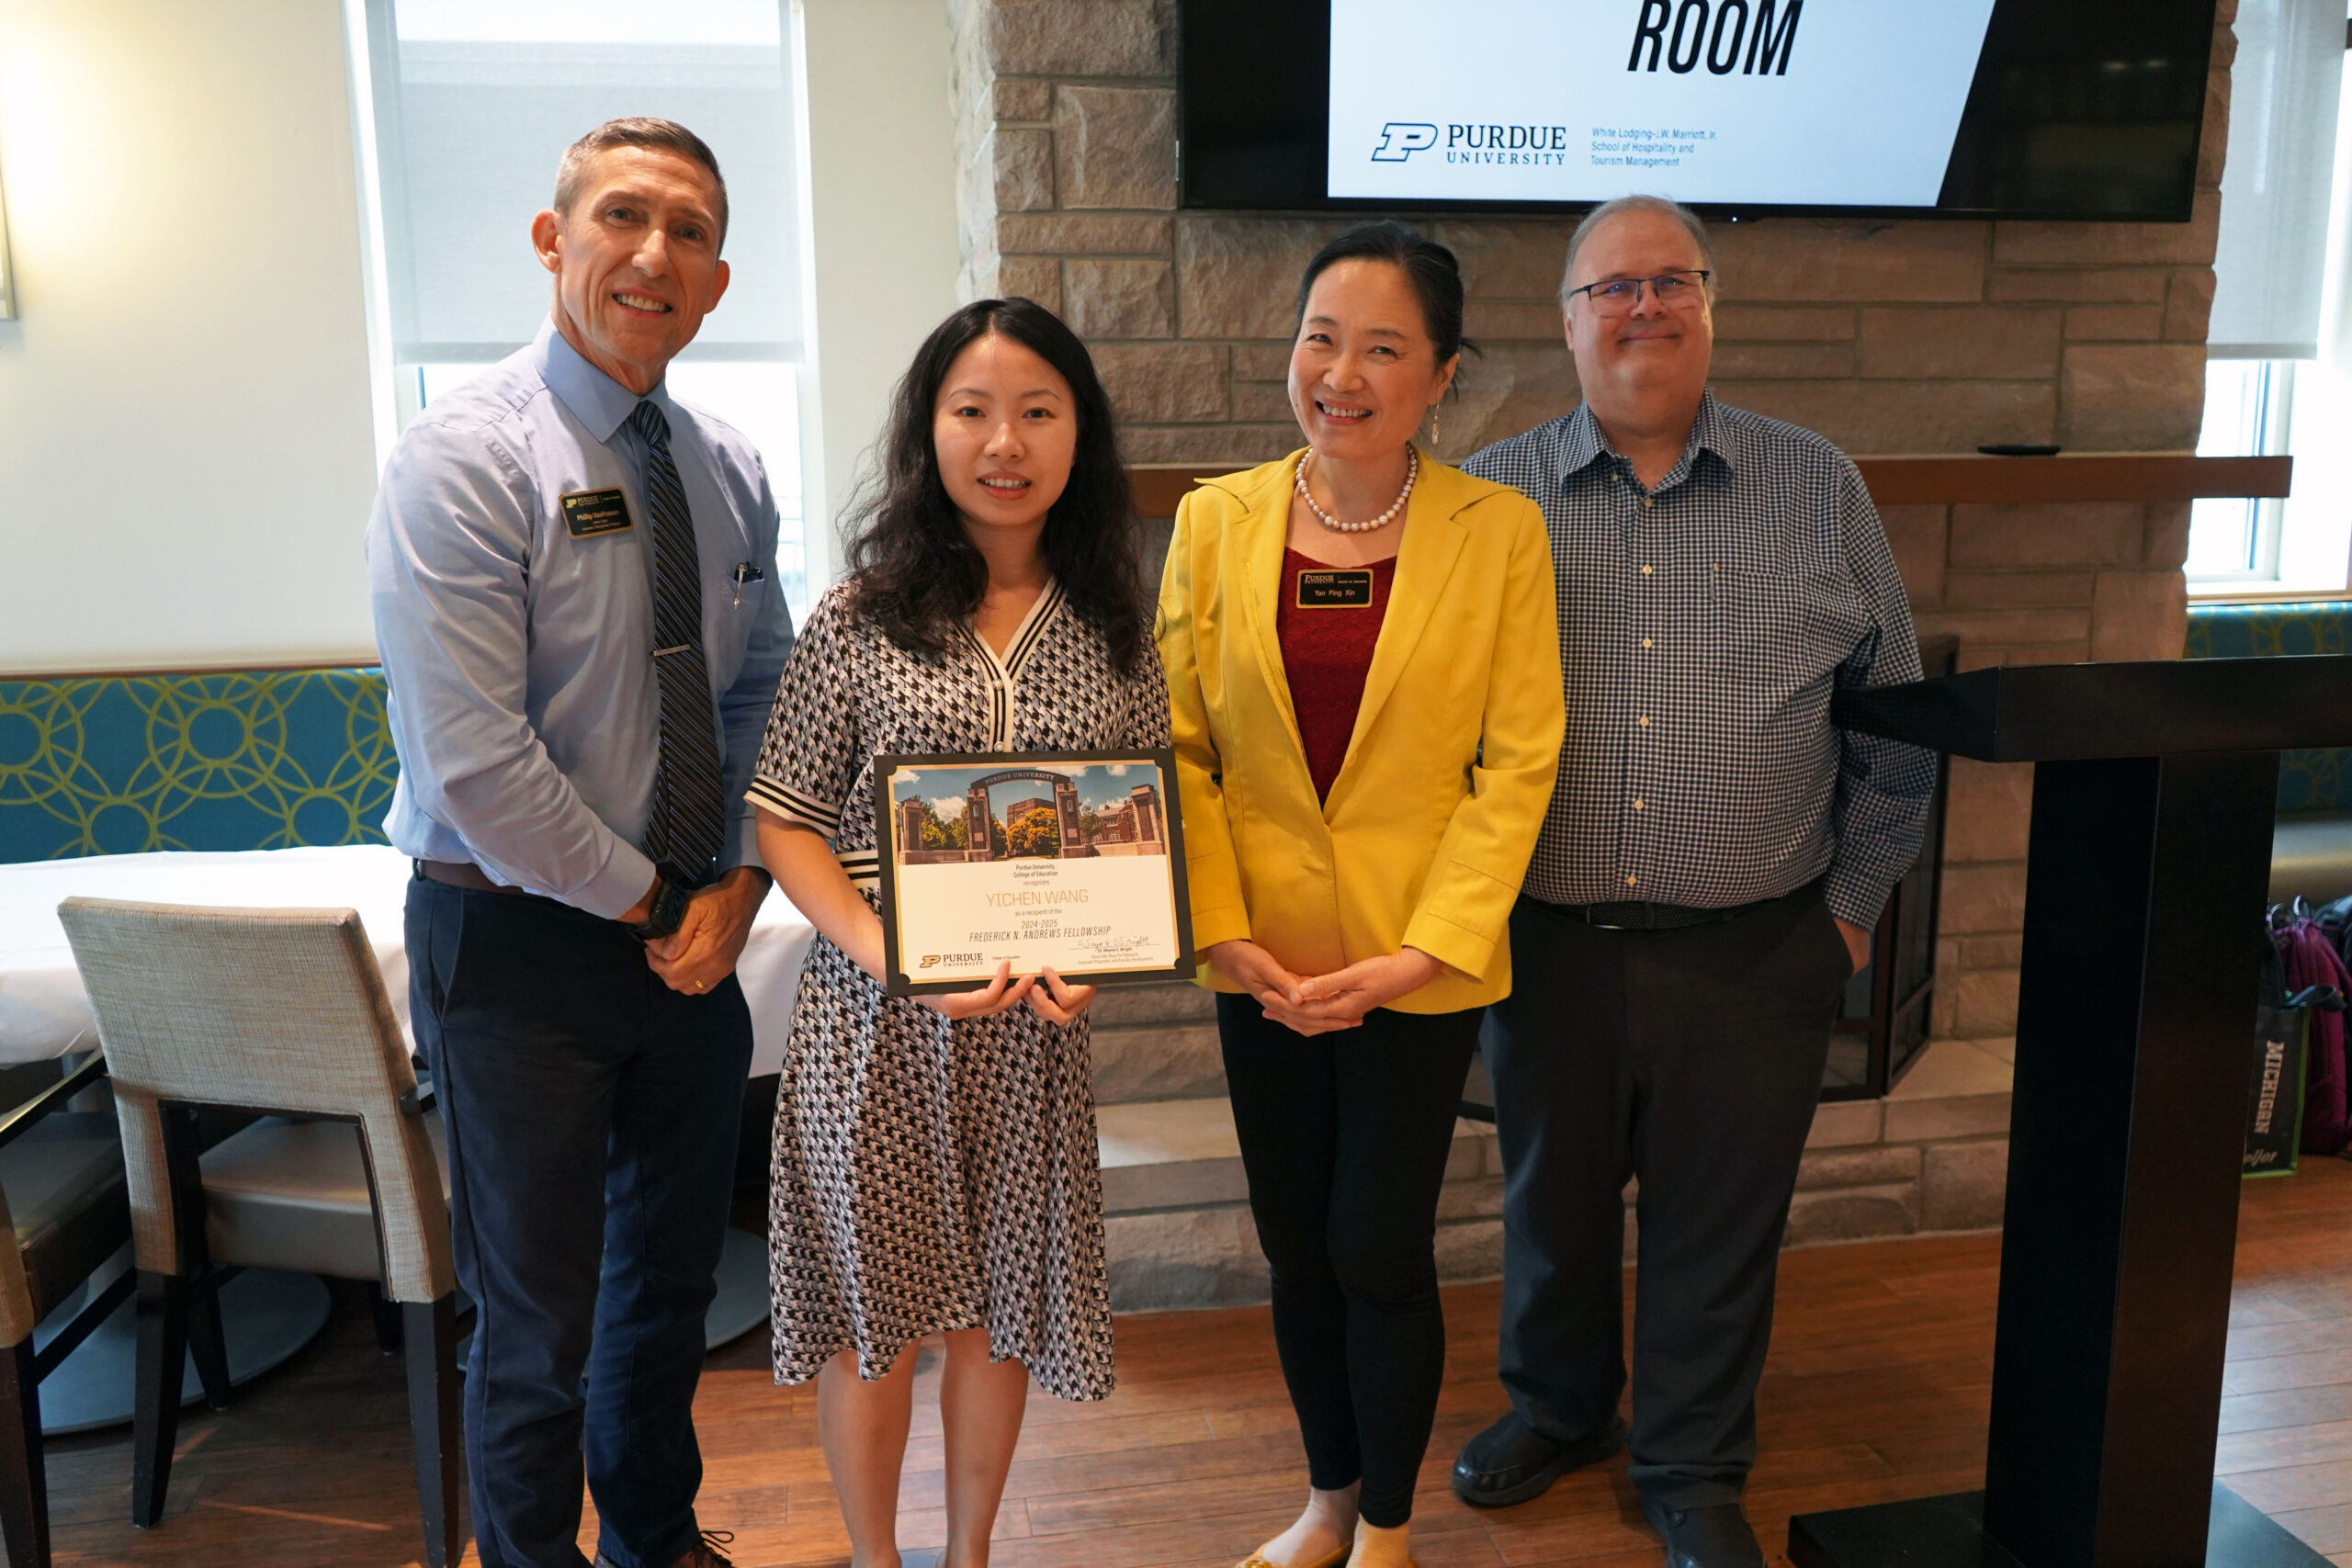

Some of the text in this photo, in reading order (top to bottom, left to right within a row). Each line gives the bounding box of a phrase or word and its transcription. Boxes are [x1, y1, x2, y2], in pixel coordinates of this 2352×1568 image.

[1626, 0, 1804, 75] ROOM
[1447, 124, 1566, 150] PURDUE
[1592, 128, 1616, 138] White
[1591, 141, 1695, 155] School of Hospitality and
[1446, 152, 1566, 165] UNIVERSITY
[1591, 155, 1679, 168] Tourism Management
[1329, 589, 1342, 598] Ping
[985, 772, 1056, 784] PURDUE UNIVERSITY
[986, 889, 1089, 908] YICHEN WANG
[1021, 919, 1058, 930] 2024-2025
[969, 925, 1111, 942] FREDERICK N. ANDREWS FELLOWSHIP
[943, 953, 983, 963] PURDUE
[2254, 1040, 2285, 1134] MICHIGAN
[2244, 1148, 2278, 1168] eijer
